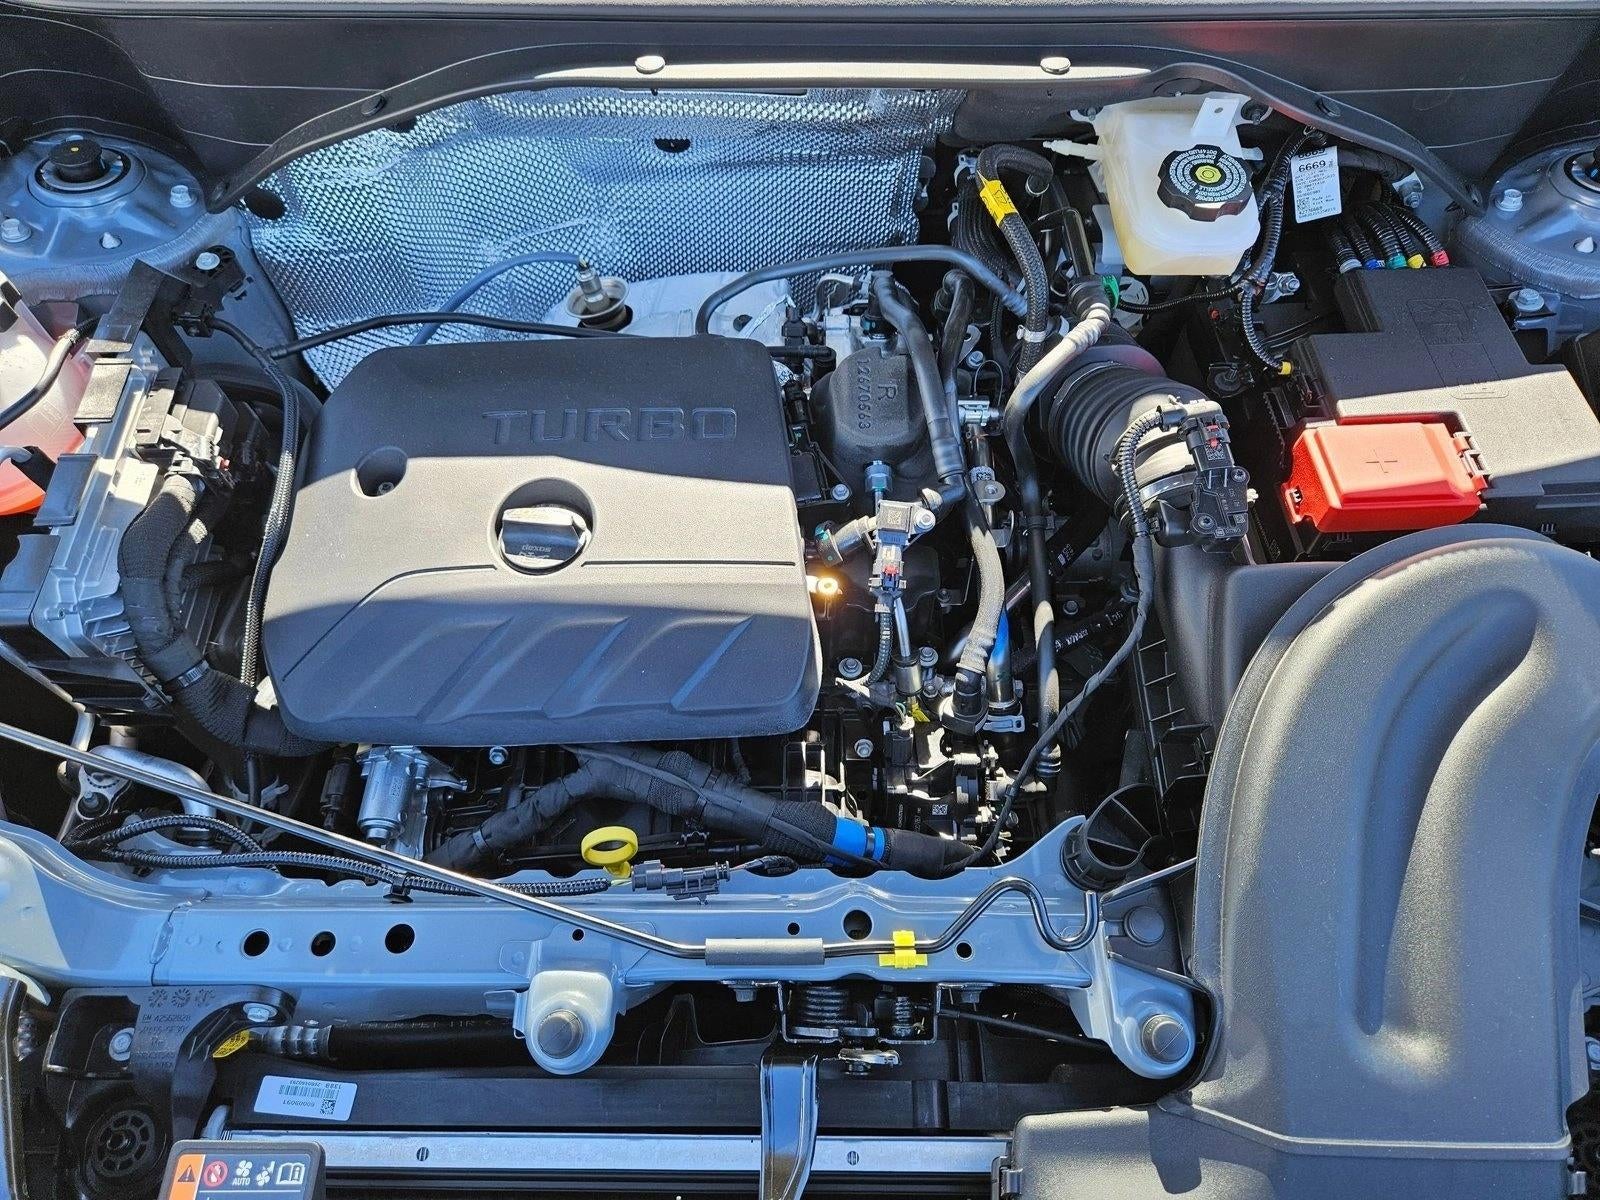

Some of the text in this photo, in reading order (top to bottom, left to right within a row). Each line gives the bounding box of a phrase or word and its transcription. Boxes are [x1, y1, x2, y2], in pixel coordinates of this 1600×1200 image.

[1298, 160, 1326, 172] 6669
[878, 384, 897, 401] R
[482, 407, 737, 445] TURBO
[232, 1177, 250, 1186] AUTO
